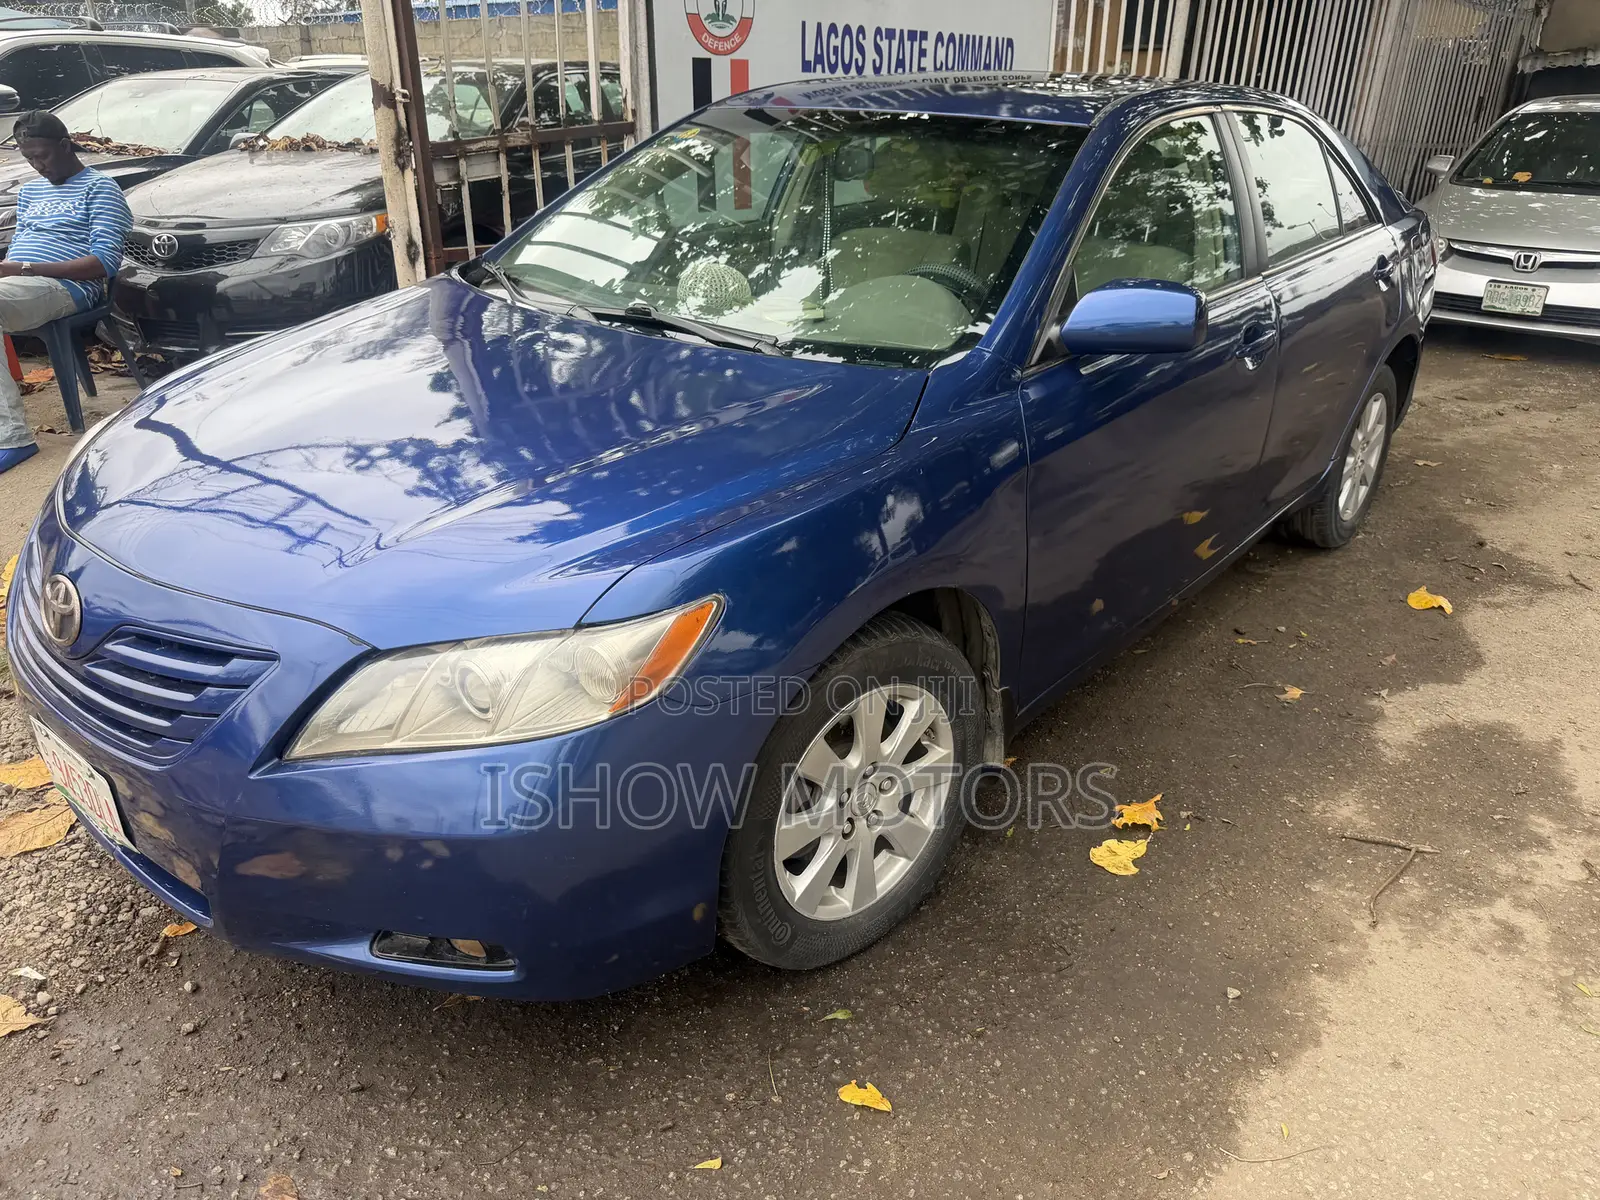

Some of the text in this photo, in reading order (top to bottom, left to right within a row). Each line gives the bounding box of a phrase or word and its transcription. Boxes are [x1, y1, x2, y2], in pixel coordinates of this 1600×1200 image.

[701, 33, 741, 51] DEFENCE
[801, 20, 1015, 75] LAGOS STATE COMMAND
